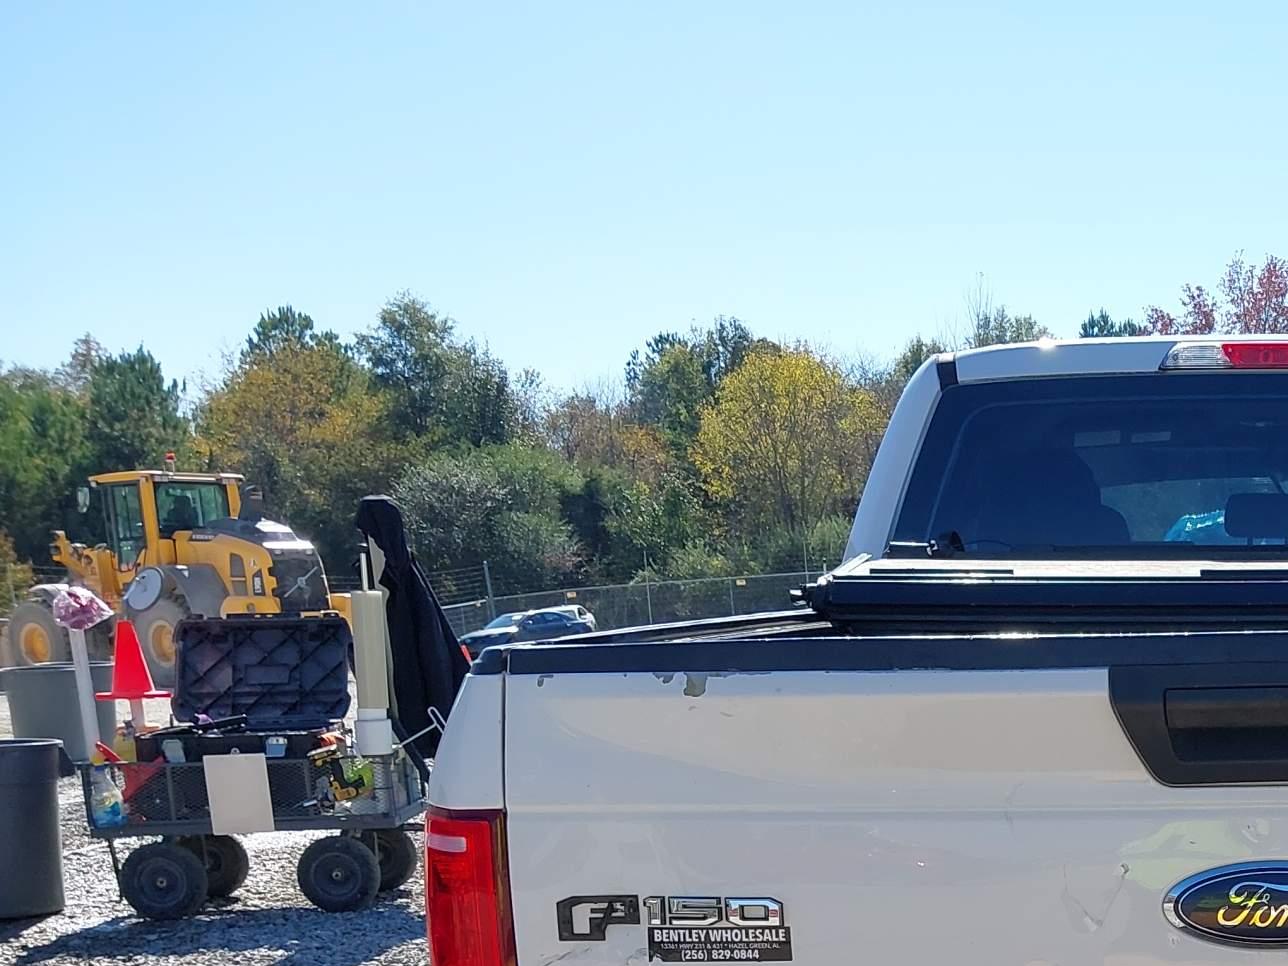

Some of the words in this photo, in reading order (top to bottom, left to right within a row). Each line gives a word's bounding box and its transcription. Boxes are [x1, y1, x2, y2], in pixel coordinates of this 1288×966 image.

[654, 929, 707, 943] BENTLEY
[709, 929, 786, 943] WHOLESALE
[681, 949, 708, 962] (256)
[711, 949, 760, 960] 829-0844
